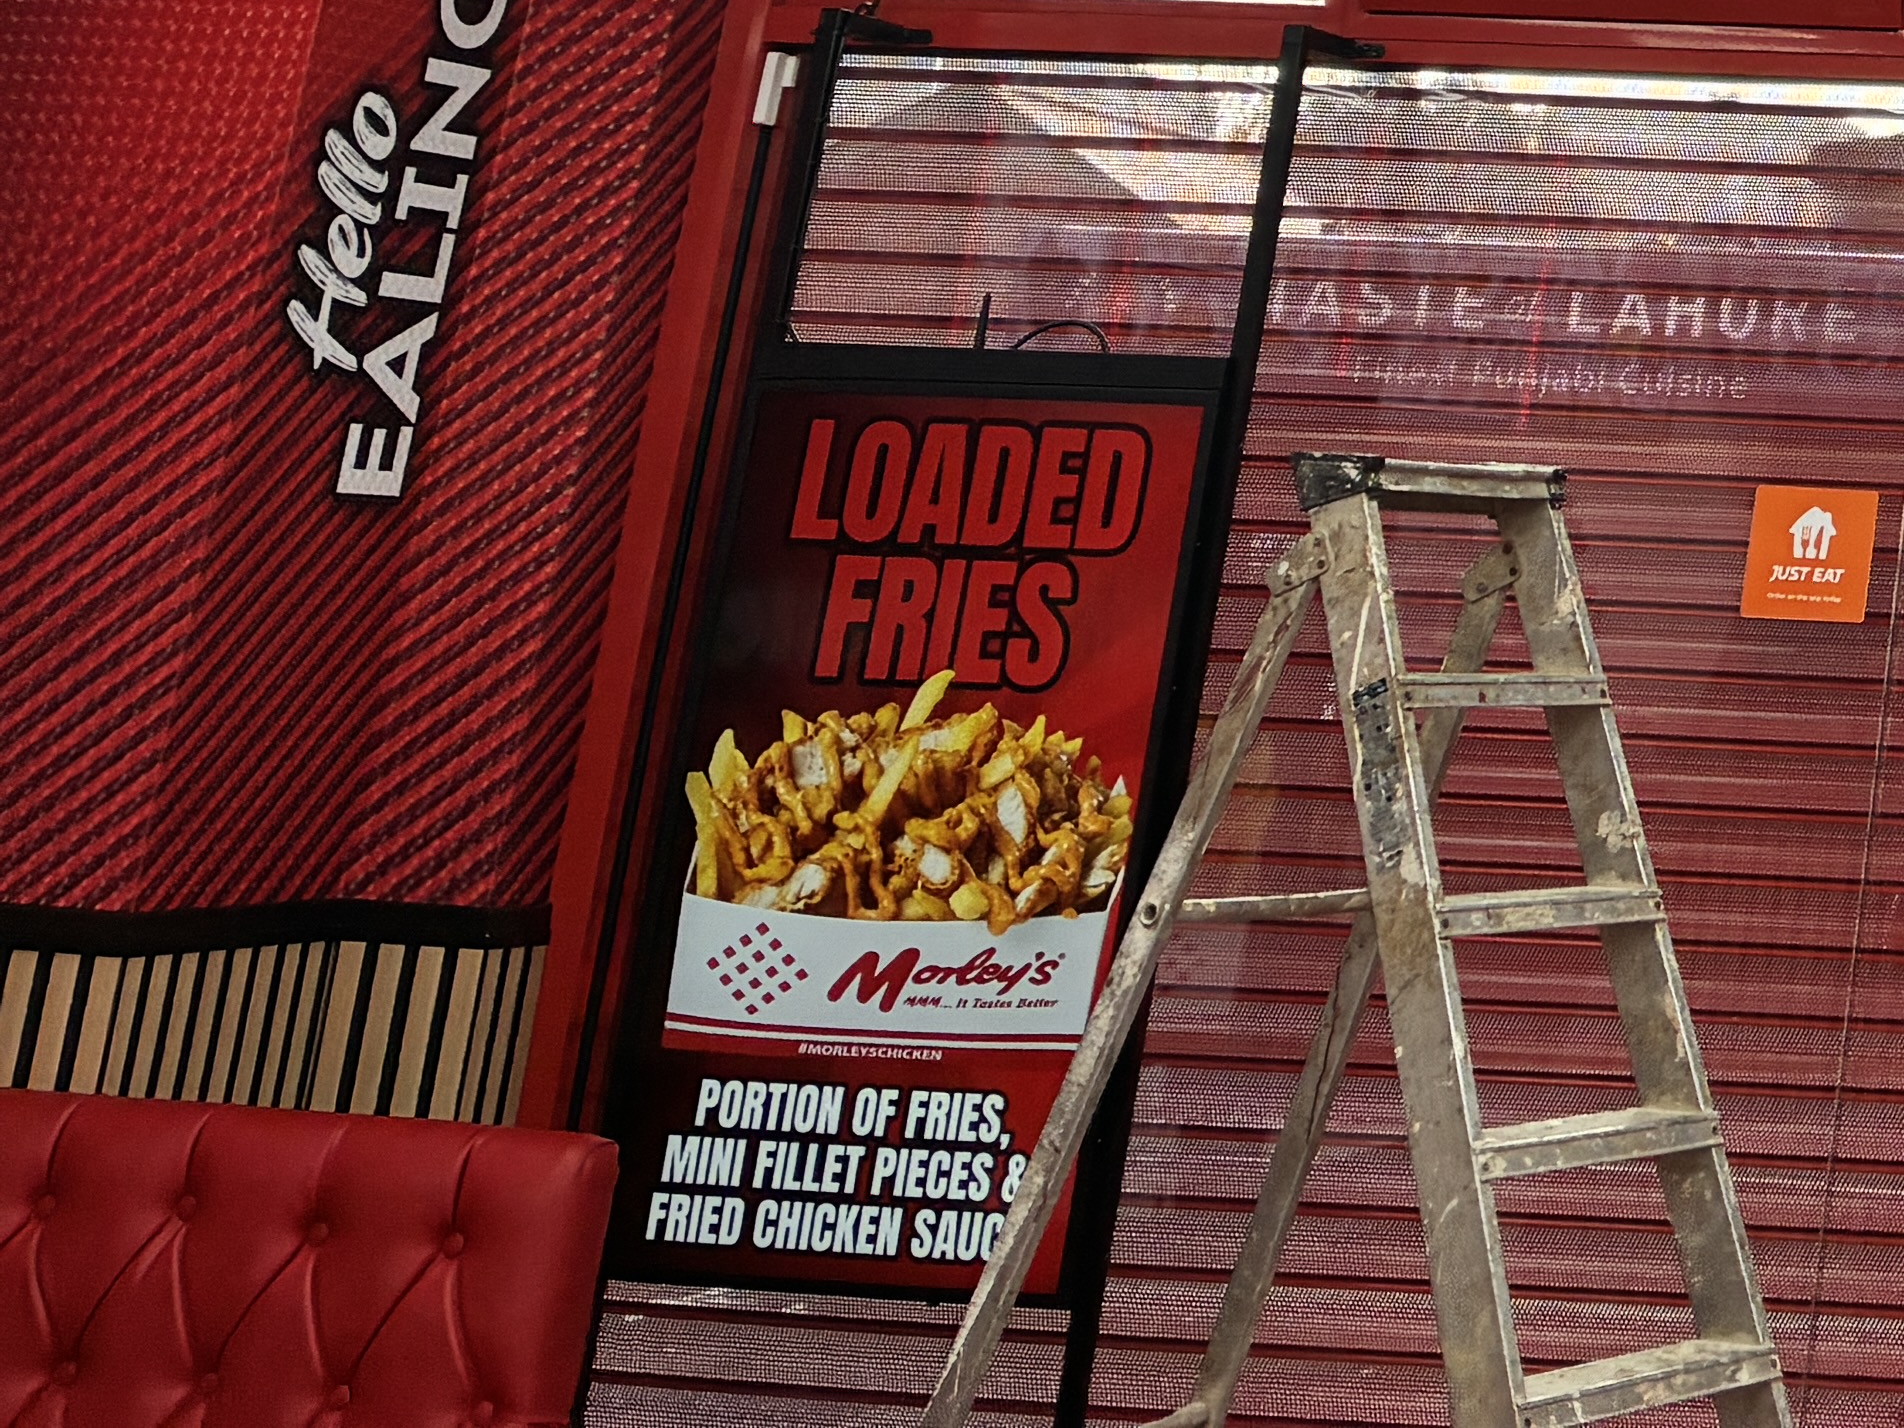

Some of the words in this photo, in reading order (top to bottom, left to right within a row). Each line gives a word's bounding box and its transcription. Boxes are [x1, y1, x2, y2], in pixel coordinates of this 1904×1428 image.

[285, 89, 400, 375] Hello
[790, 420, 1148, 554] LOADED
[1769, 565, 1811, 582] JUST
[1812, 567, 1846, 584] EAT
[813, 554, 1072, 685] FRIES
[827, 946, 1060, 1013] Morley's
[797, 1042, 943, 1062] #MORLEYSCHICKEN
[694, 1077, 846, 1136] PORTION
[851, 1087, 899, 1138] OF
[904, 1089, 1012, 1150] FRIES,
[661, 1134, 747, 1188] MINI
[751, 1140, 866, 1195] FILLET
[869, 1148, 995, 1202] PIECES
[1000, 1154, 1029, 1203] &
[645, 1192, 745, 1246] FRIED
[752, 1199, 904, 1257] CHICKEN
[910, 1207, 1006, 1262] SAUC
